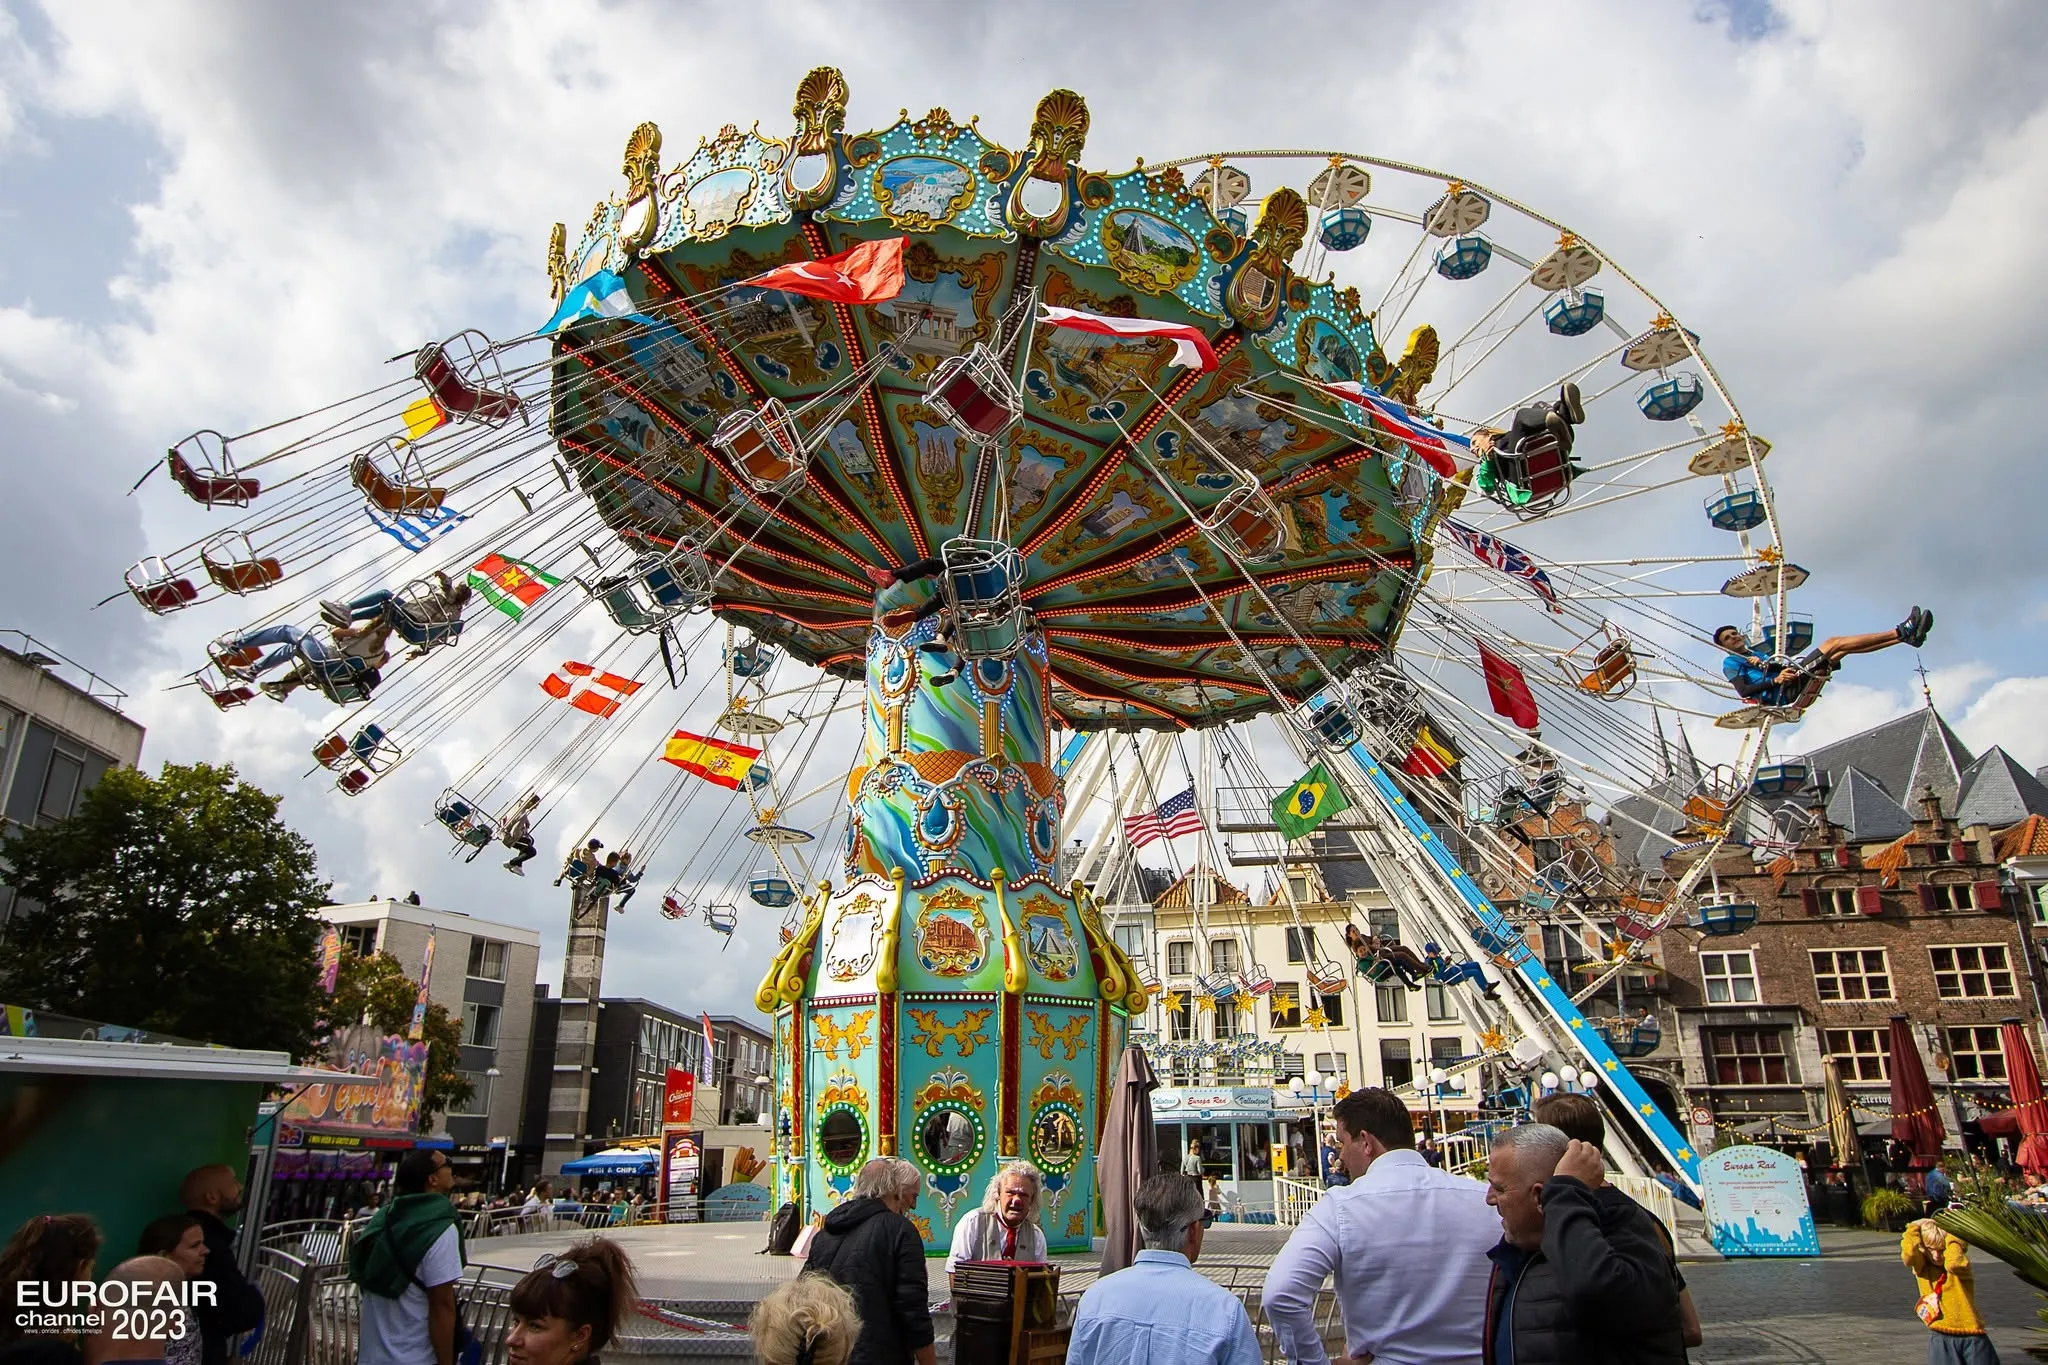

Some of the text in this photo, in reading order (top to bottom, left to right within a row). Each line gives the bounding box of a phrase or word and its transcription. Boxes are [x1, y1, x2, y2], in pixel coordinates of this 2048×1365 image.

[1188, 1096, 1227, 1106] Europa Rad
[1723, 1160, 1776, 1173] Europa Rad
